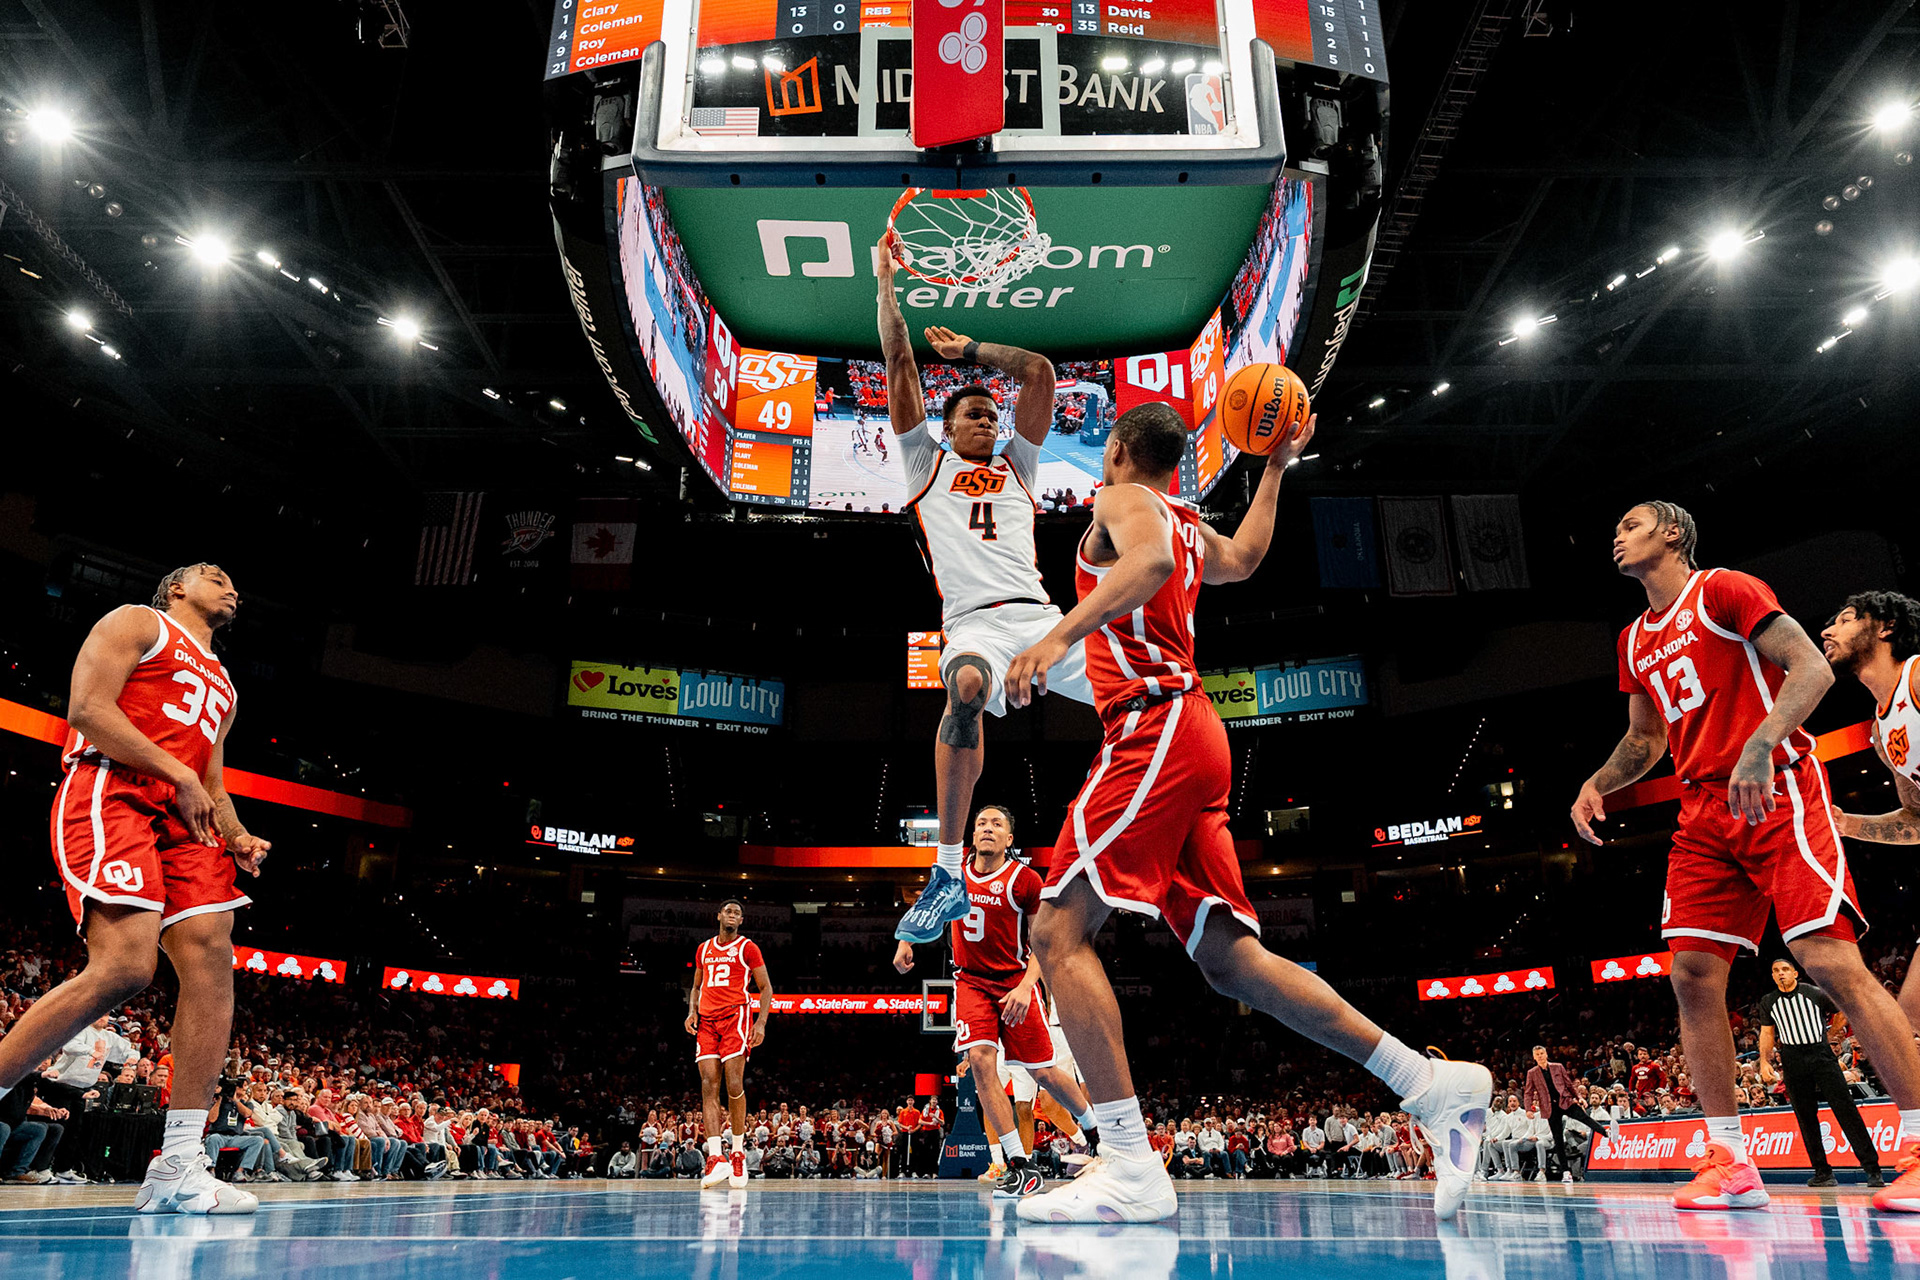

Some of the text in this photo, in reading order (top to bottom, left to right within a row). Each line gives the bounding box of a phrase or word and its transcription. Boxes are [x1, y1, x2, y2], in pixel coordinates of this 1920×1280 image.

[563, 3, 619, 24] 1 Clary
[790, 4, 846, 17] 13 0
[865, 7, 891, 16] REB
[1042, 8, 1059, 17] 30
[1078, 4, 1151, 20] 13 Davis
[1320, 5, 1367, 26] 15 1
[1358, 0, 1365, 10] 1
[558, 14, 643, 40] 4 Coleman
[792, 20, 845, 34] 0 0
[1078, 20, 1097, 32] 35
[1107, 22, 1144, 36] Reid
[1324, 22, 1369, 41] 9 1
[556, 38, 606, 57] 9 Roy
[1327, 38, 1371, 58] 2 1
[551, 47, 639, 74] 21 Coleman
[1329, 54, 1375, 74] 5 0
[1058, 65, 1166, 113] BANK
[1195, 124, 1213, 134] NBA
[564, 256, 597, 333] center
[1310, 300, 1356, 390] paycom
[589, 336, 643, 420] paycom
[713, 369, 728, 410] 50
[1203, 371, 1217, 410] 49
[758, 400, 792, 430] 49
[1255, 377, 1285, 437] Wilson
[736, 432, 756, 440] PLAYER
[949, 467, 1008, 497] OSU
[505, 511, 555, 530] THUNDER
[969, 502, 998, 541] 4
[1636, 630, 1699, 672] OKLAHOMA
[174, 649, 233, 701] OKLAHOMA
[683, 682, 733, 710] LOUD
[740, 685, 780, 719] CITY
[1262, 671, 1312, 709] LOUD
[1318, 669, 1362, 699] CITY
[1649, 655, 1706, 724] 13
[161, 669, 230, 745] 35
[582, 709, 769, 735] BRING THE THUNDER EXIT NOW
[1228, 717, 1282, 729] THUNDER
[1299, 713, 1325, 722] EXIT
[1328, 709, 1355, 719] NOW
[544, 826, 616, 849] BEDLAM
[1388, 816, 1462, 840] BEDLAM
[1404, 833, 1449, 845] BASKETBALL
[558, 843, 601, 855] BASKETBALL
[102, 859, 144, 892] OU
[963, 906, 985, 942] 9
[707, 964, 730, 987] 12
[815, 999, 866, 1010] StateFarm
